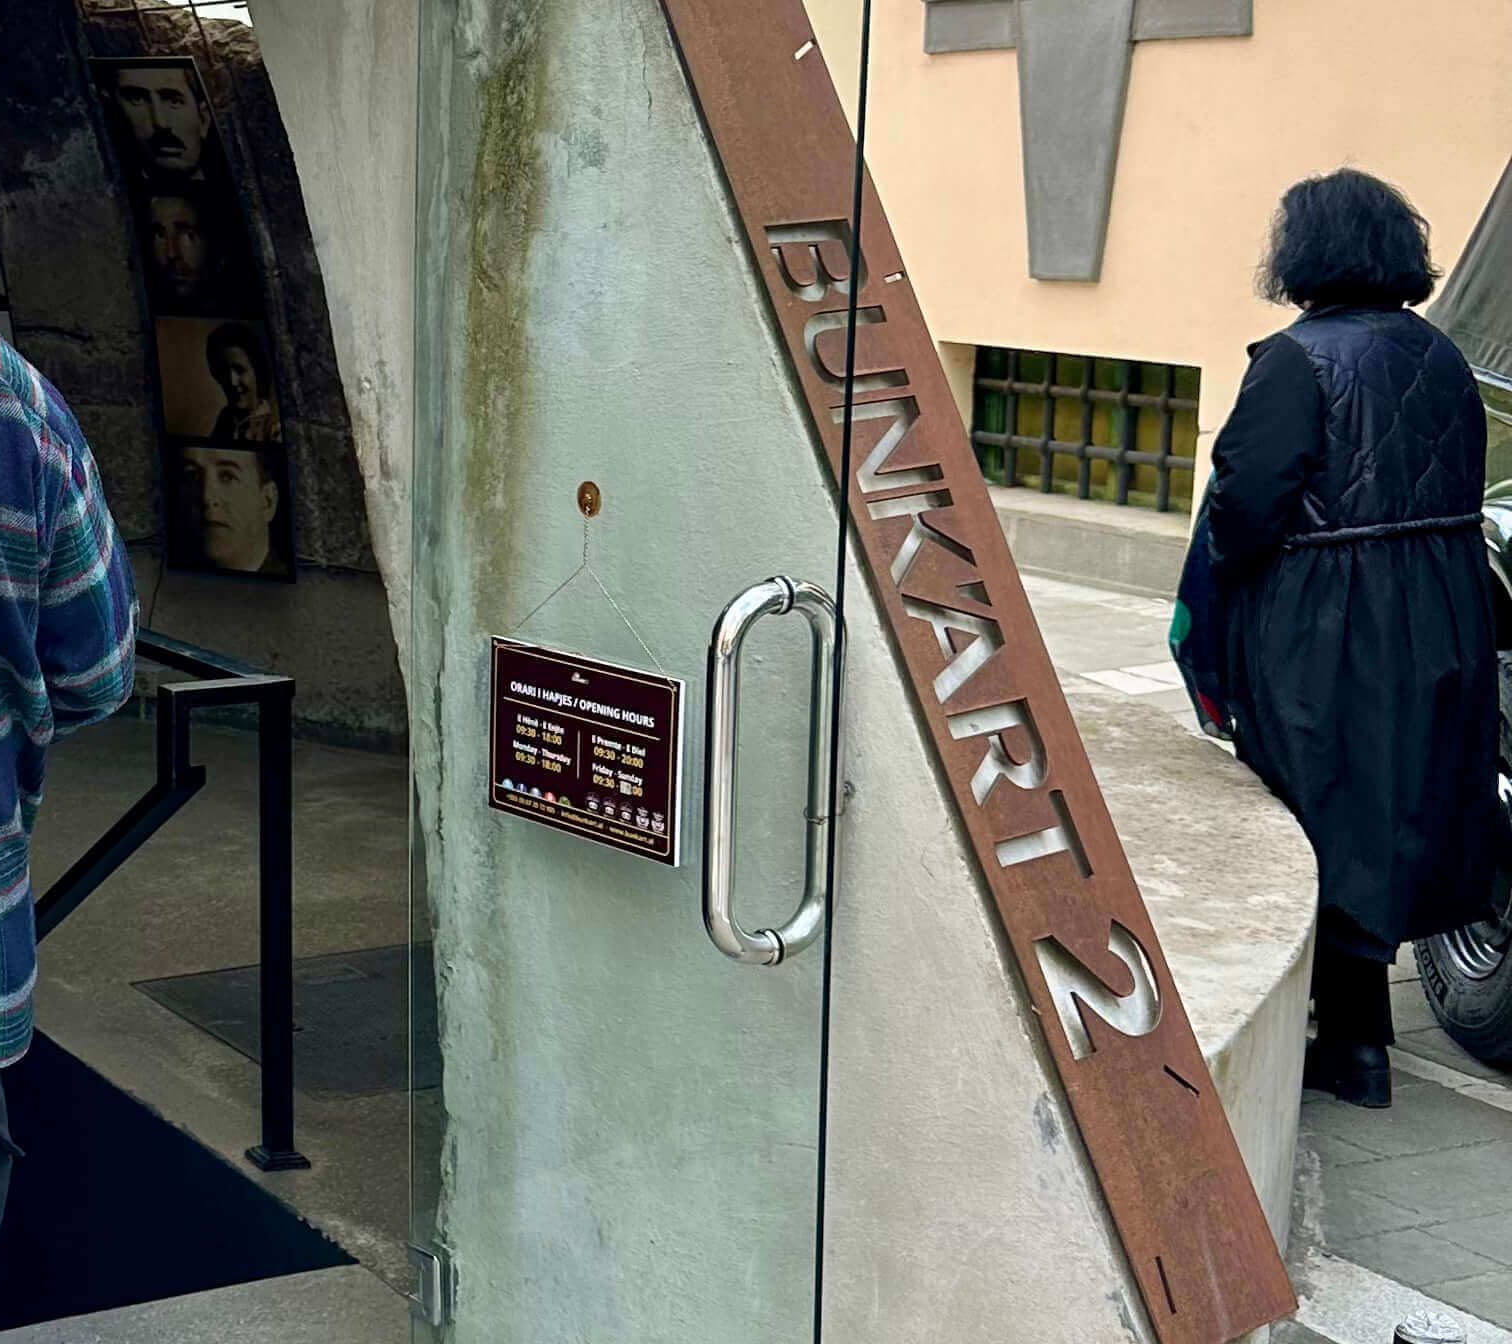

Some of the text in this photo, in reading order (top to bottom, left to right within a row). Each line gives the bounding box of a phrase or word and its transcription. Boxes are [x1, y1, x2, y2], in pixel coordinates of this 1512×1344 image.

[764, 218, 1166, 1060] BUNK'ART 2
[510, 680, 537, 697] ORARI
[542, 688, 573, 707] HAPJES
[579, 699, 621, 720] OPENING
[621, 709, 656, 728] HOURS
[515, 723, 536, 738] 09:30
[513, 740, 538, 755] Monday
[541, 747, 572, 766] Thursday
[593, 745, 616, 761] 09:30
[620, 752, 645, 769] 20:00
[591, 761, 614, 778] Friday
[617, 770, 644, 787] Sunday
